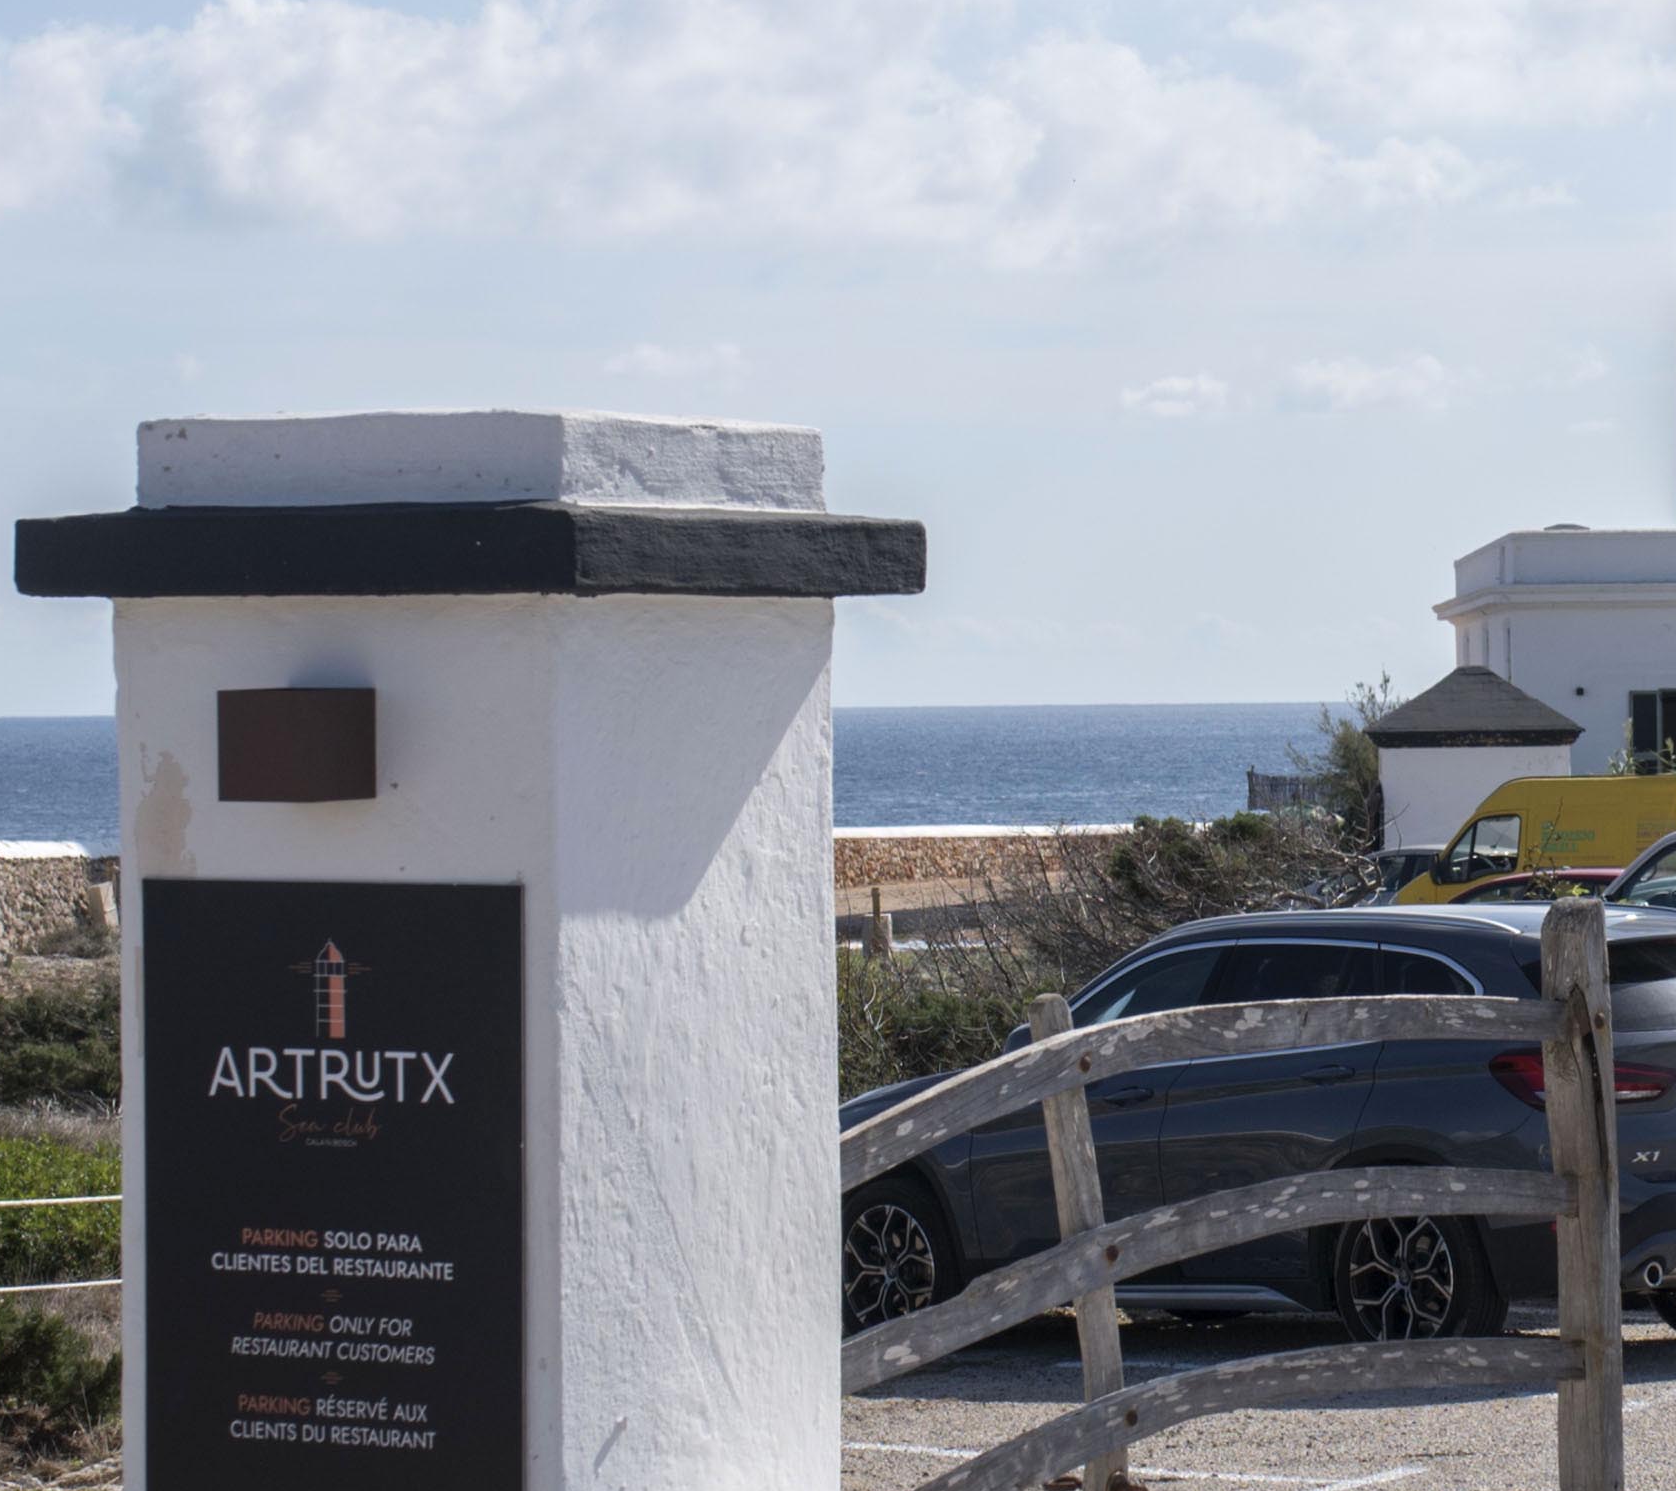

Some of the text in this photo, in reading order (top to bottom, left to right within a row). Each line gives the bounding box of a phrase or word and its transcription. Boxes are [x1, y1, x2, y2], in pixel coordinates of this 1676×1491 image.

[208, 1046, 455, 1104] ARTRUTX
[278, 1103, 382, 1143] Sea club
[1632, 1150, 1661, 1163] X1
[241, 1227, 423, 1253] PARKING SOLO PARA
[211, 1252, 454, 1281] CLIENTES DEL RESTAURANTE
[253, 1312, 413, 1337] PARKING ONLY FOR
[231, 1336, 436, 1365] RESTAURANT CUSTOMERS
[238, 1394, 428, 1423] PARKING RÉSERVÉ AUX
[230, 1420, 436, 1450] CLIENTS DU RESTAURANT
